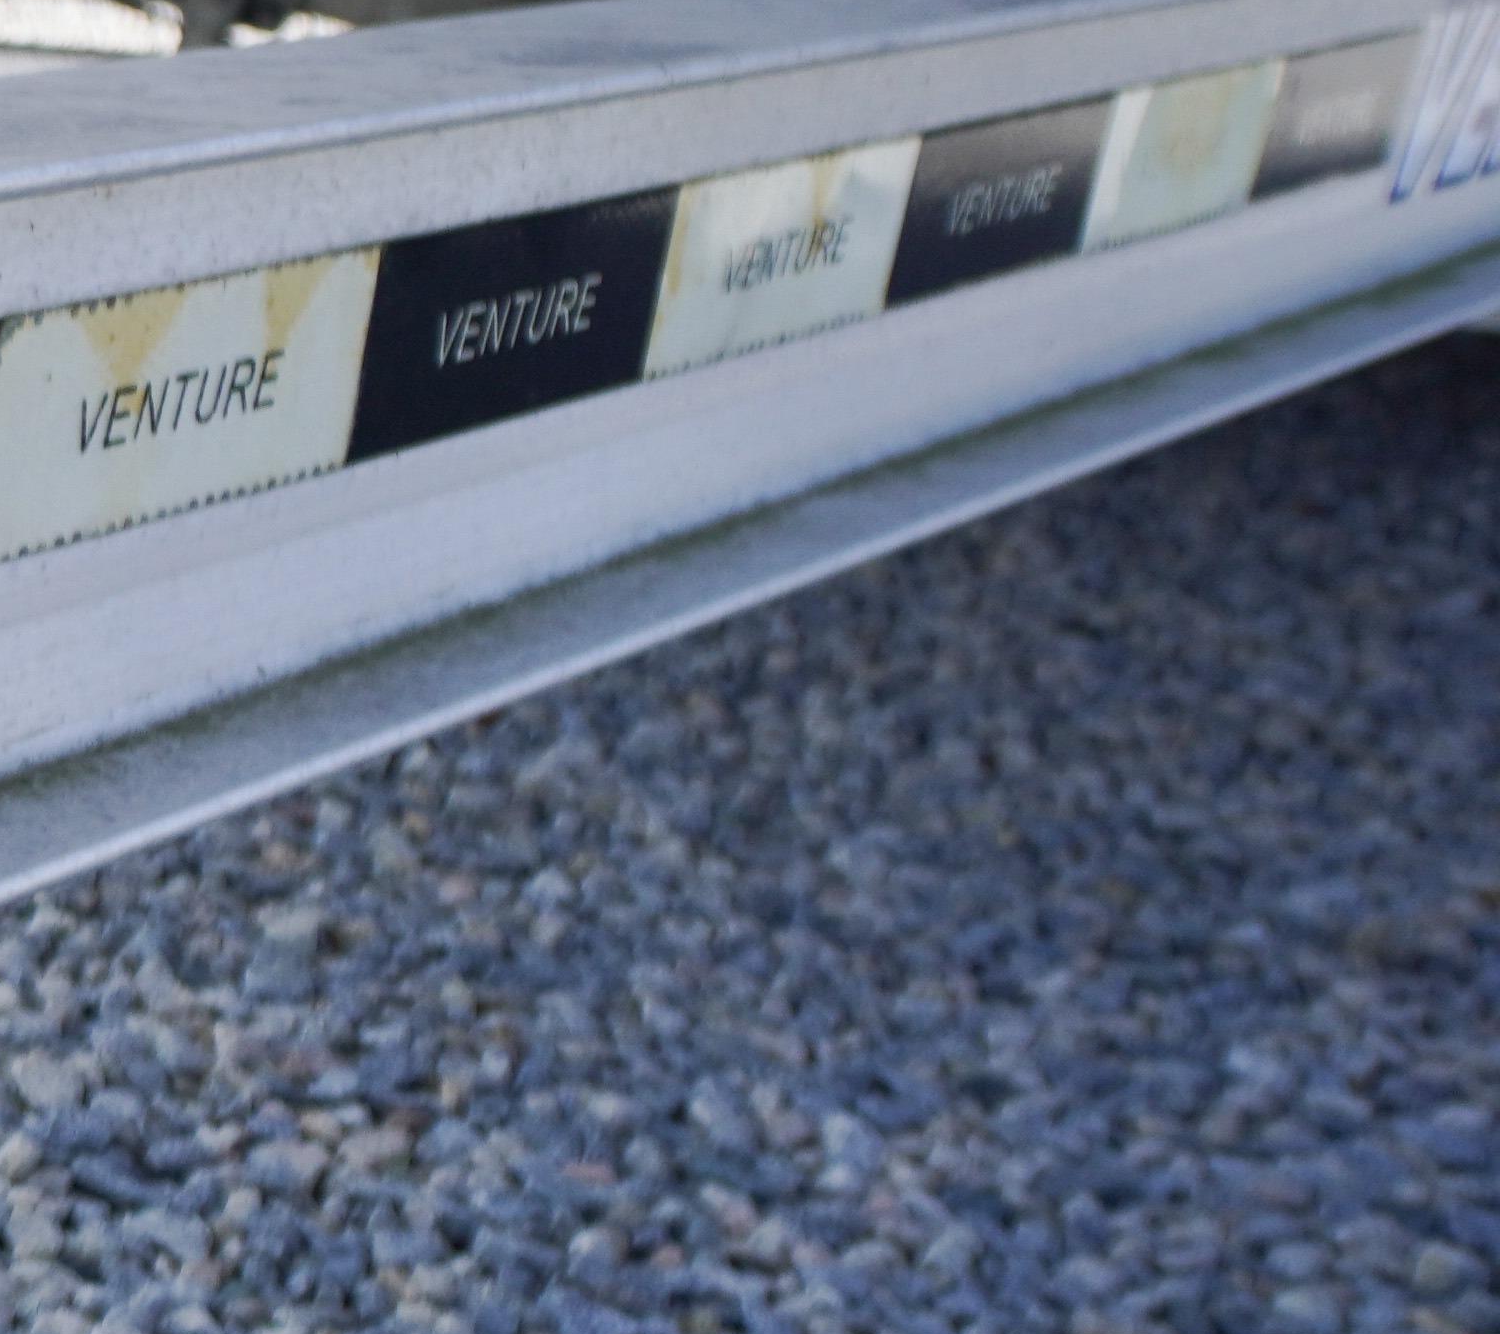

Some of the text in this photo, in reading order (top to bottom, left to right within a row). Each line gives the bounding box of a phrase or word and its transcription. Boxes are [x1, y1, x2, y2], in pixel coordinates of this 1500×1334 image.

[948, 165, 1065, 237] VENTURE
[722, 213, 856, 295] VENTURE
[435, 270, 603, 369] VENTURE
[78, 348, 286, 455] VENTURE
